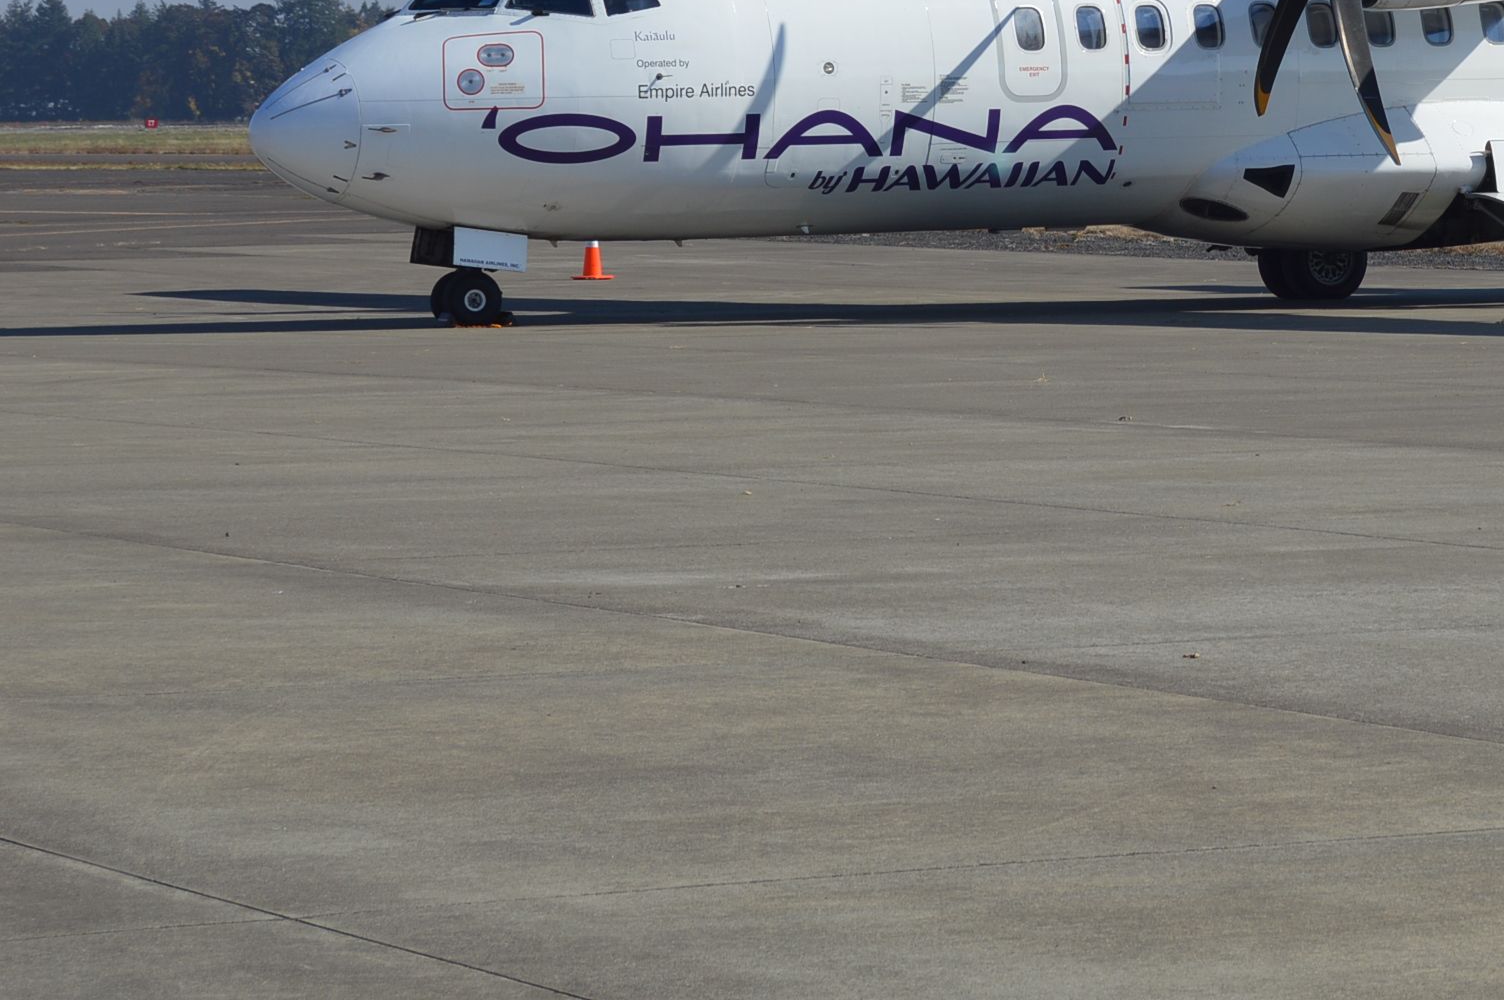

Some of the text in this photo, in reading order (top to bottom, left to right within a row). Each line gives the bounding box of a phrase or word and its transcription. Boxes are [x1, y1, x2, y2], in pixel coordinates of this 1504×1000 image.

[636, 58, 689, 69] Operated by
[638, 81, 756, 102] Empire Airlines
[808, 159, 1115, 195] by HAWAIIAN
